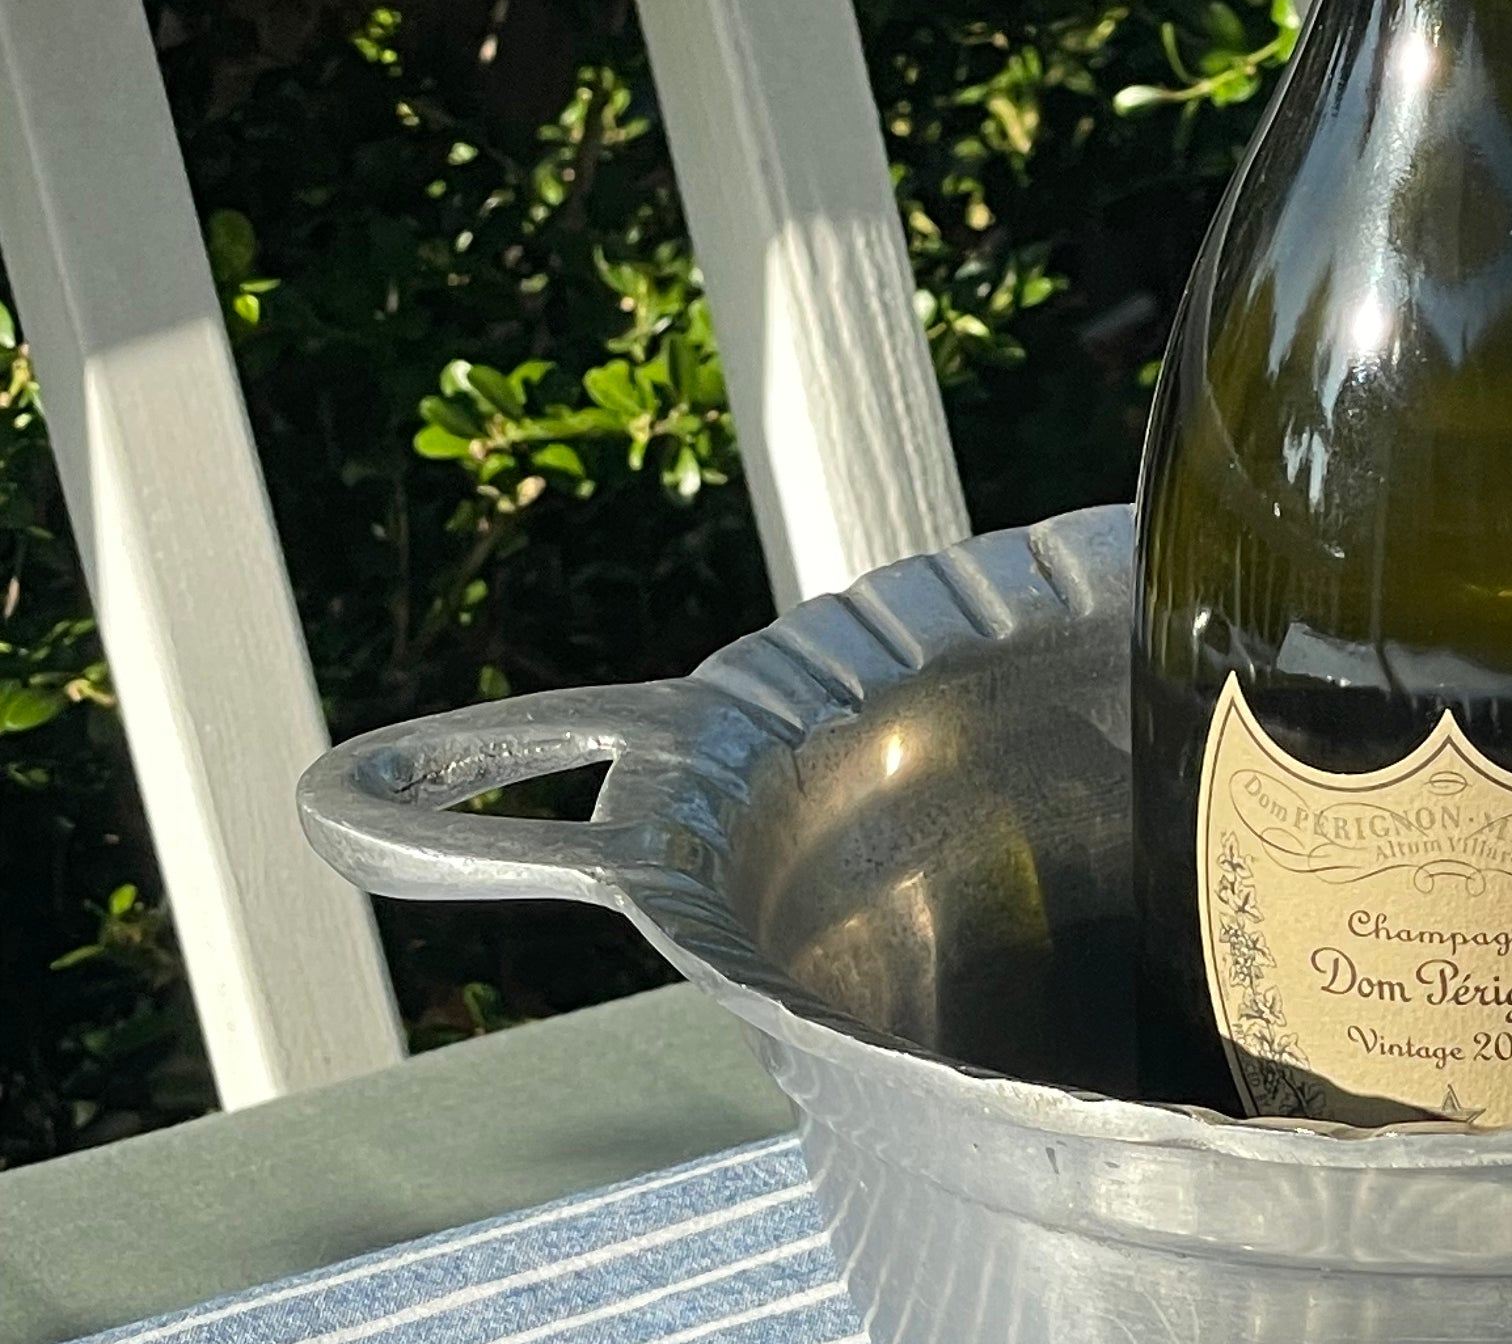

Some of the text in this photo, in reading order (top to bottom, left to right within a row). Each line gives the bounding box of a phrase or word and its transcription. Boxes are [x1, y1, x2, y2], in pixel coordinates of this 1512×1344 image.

[1243, 773, 1288, 823] Dom
[1310, 946, 1412, 1003] Dom
[1347, 1024, 1467, 1070] Vintage
